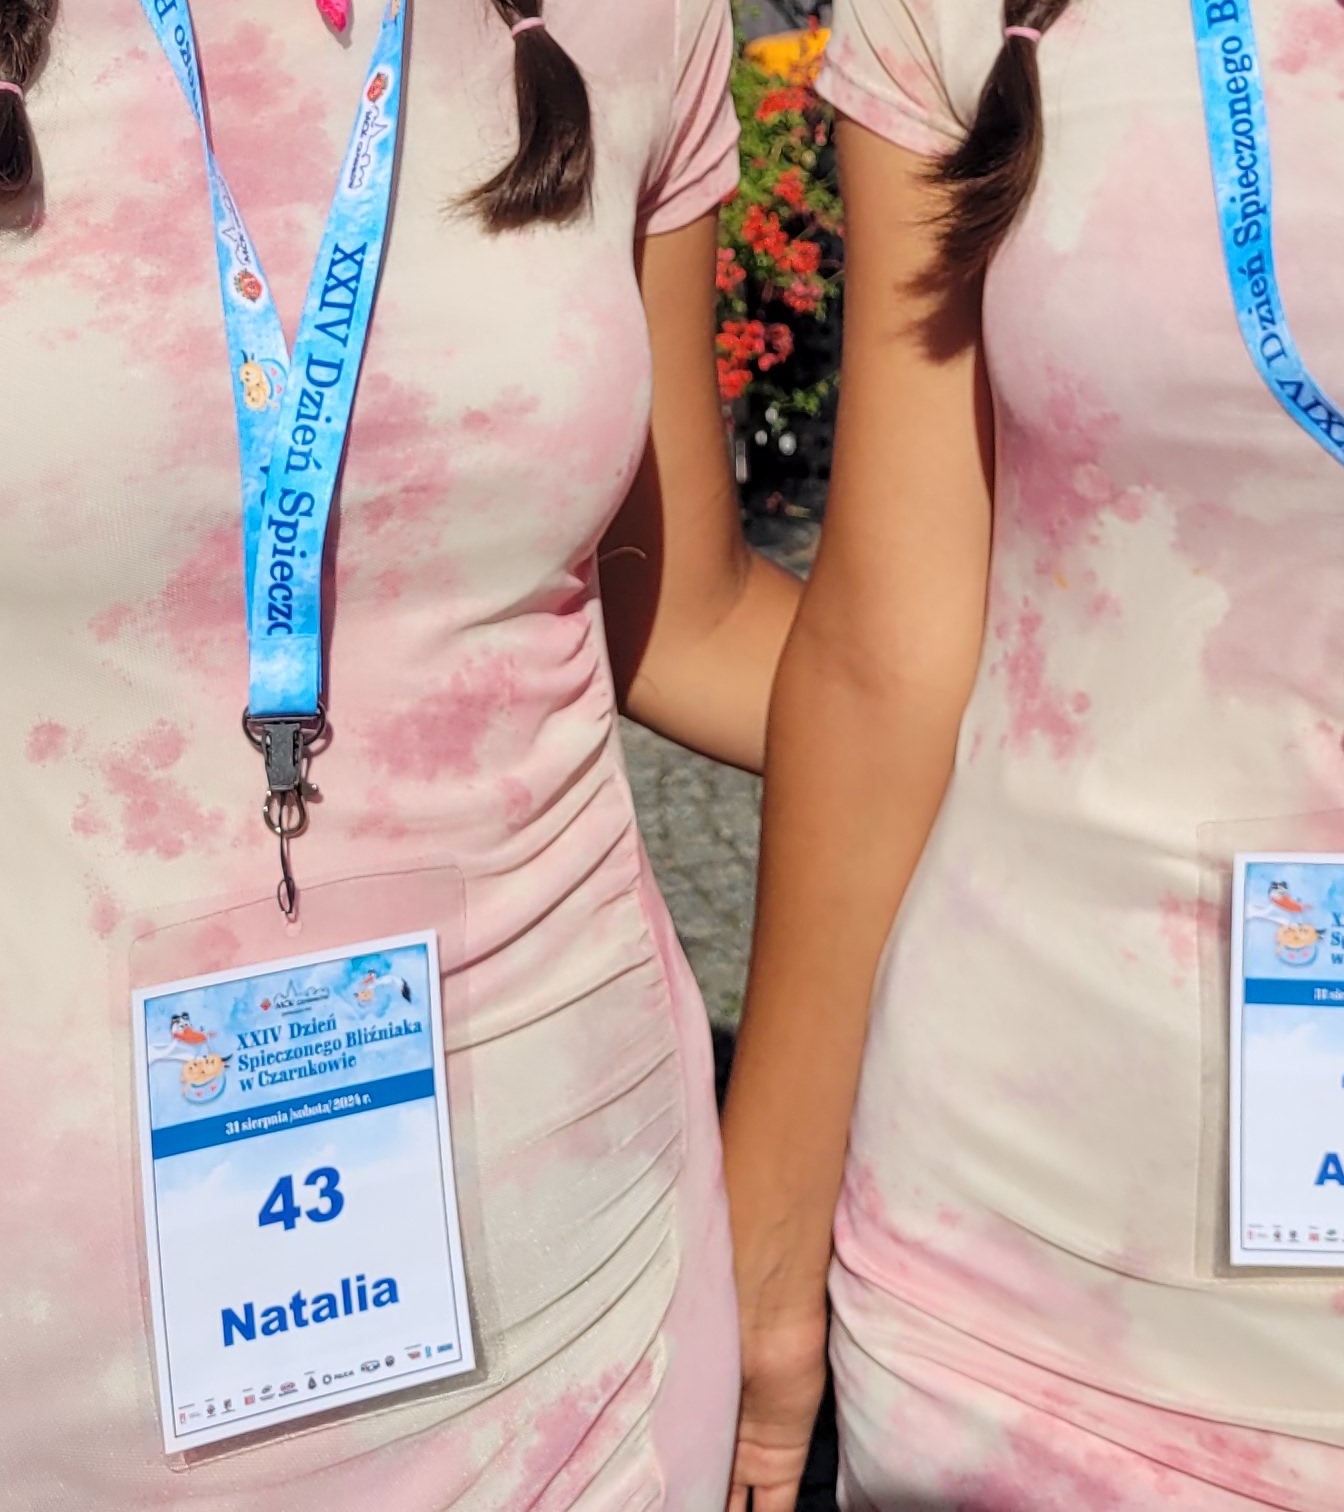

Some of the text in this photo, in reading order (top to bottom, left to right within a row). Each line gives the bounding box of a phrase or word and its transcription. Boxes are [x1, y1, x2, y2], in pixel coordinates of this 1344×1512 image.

[1220, 36, 1269, 250] Spieczonego
[316, 242, 368, 348] XXIV
[1237, 252, 1289, 369] Dzień
[284, 352, 345, 475] Dzień
[237, 1013, 338, 1051] XXIV Dzień
[238, 1019, 424, 1073] Spieczonego Bliźniaka
[258, 1053, 358, 1088] Czarnkowie
[241, 1111, 289, 1132] sierpnia
[257, 1166, 346, 1232] 43
[220, 1273, 401, 1347] Natalia
